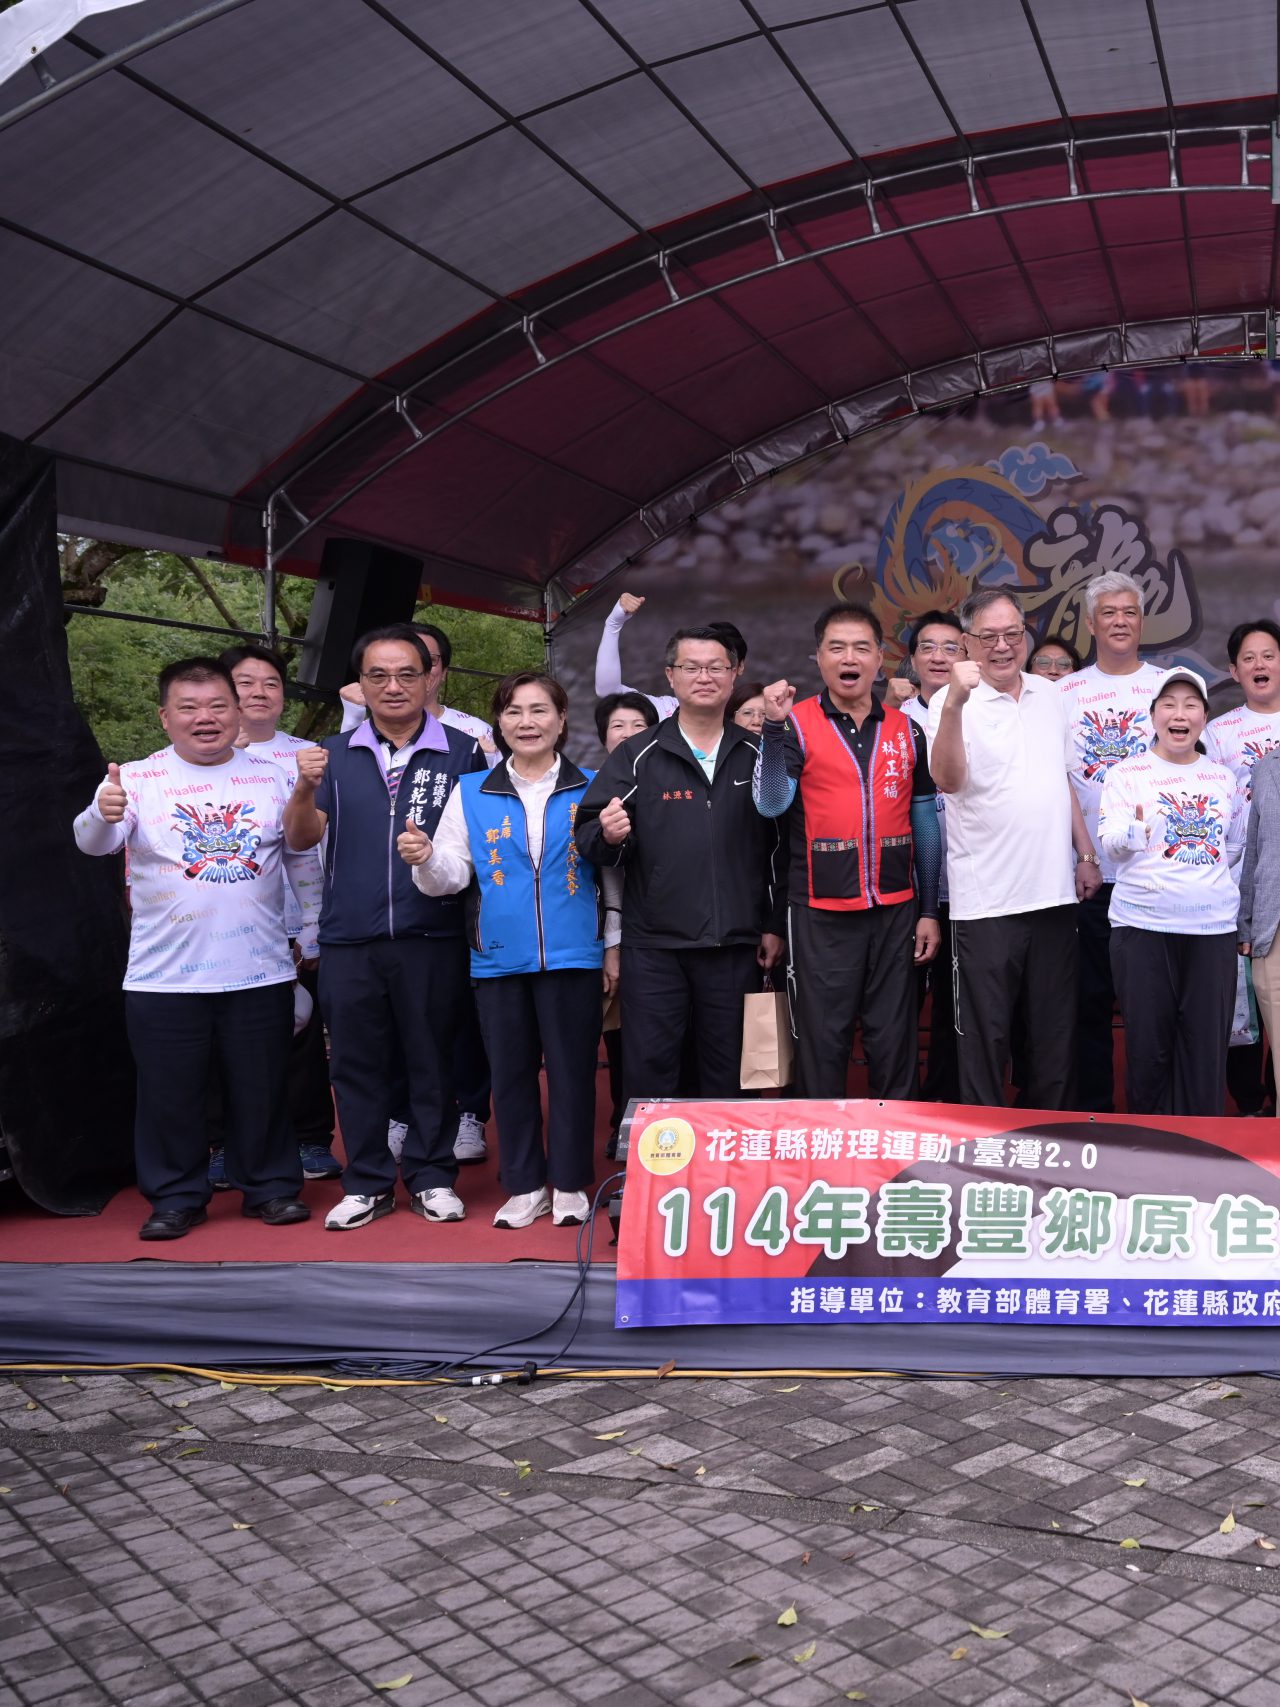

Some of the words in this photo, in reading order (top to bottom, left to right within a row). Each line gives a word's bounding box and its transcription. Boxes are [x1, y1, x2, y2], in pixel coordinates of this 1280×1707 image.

[231, 774, 276, 786] Hualien
[882, 740, 900, 799] 林正福
[164, 782, 214, 798] Hualien
[405, 769, 430, 826] 鄭乾龍
